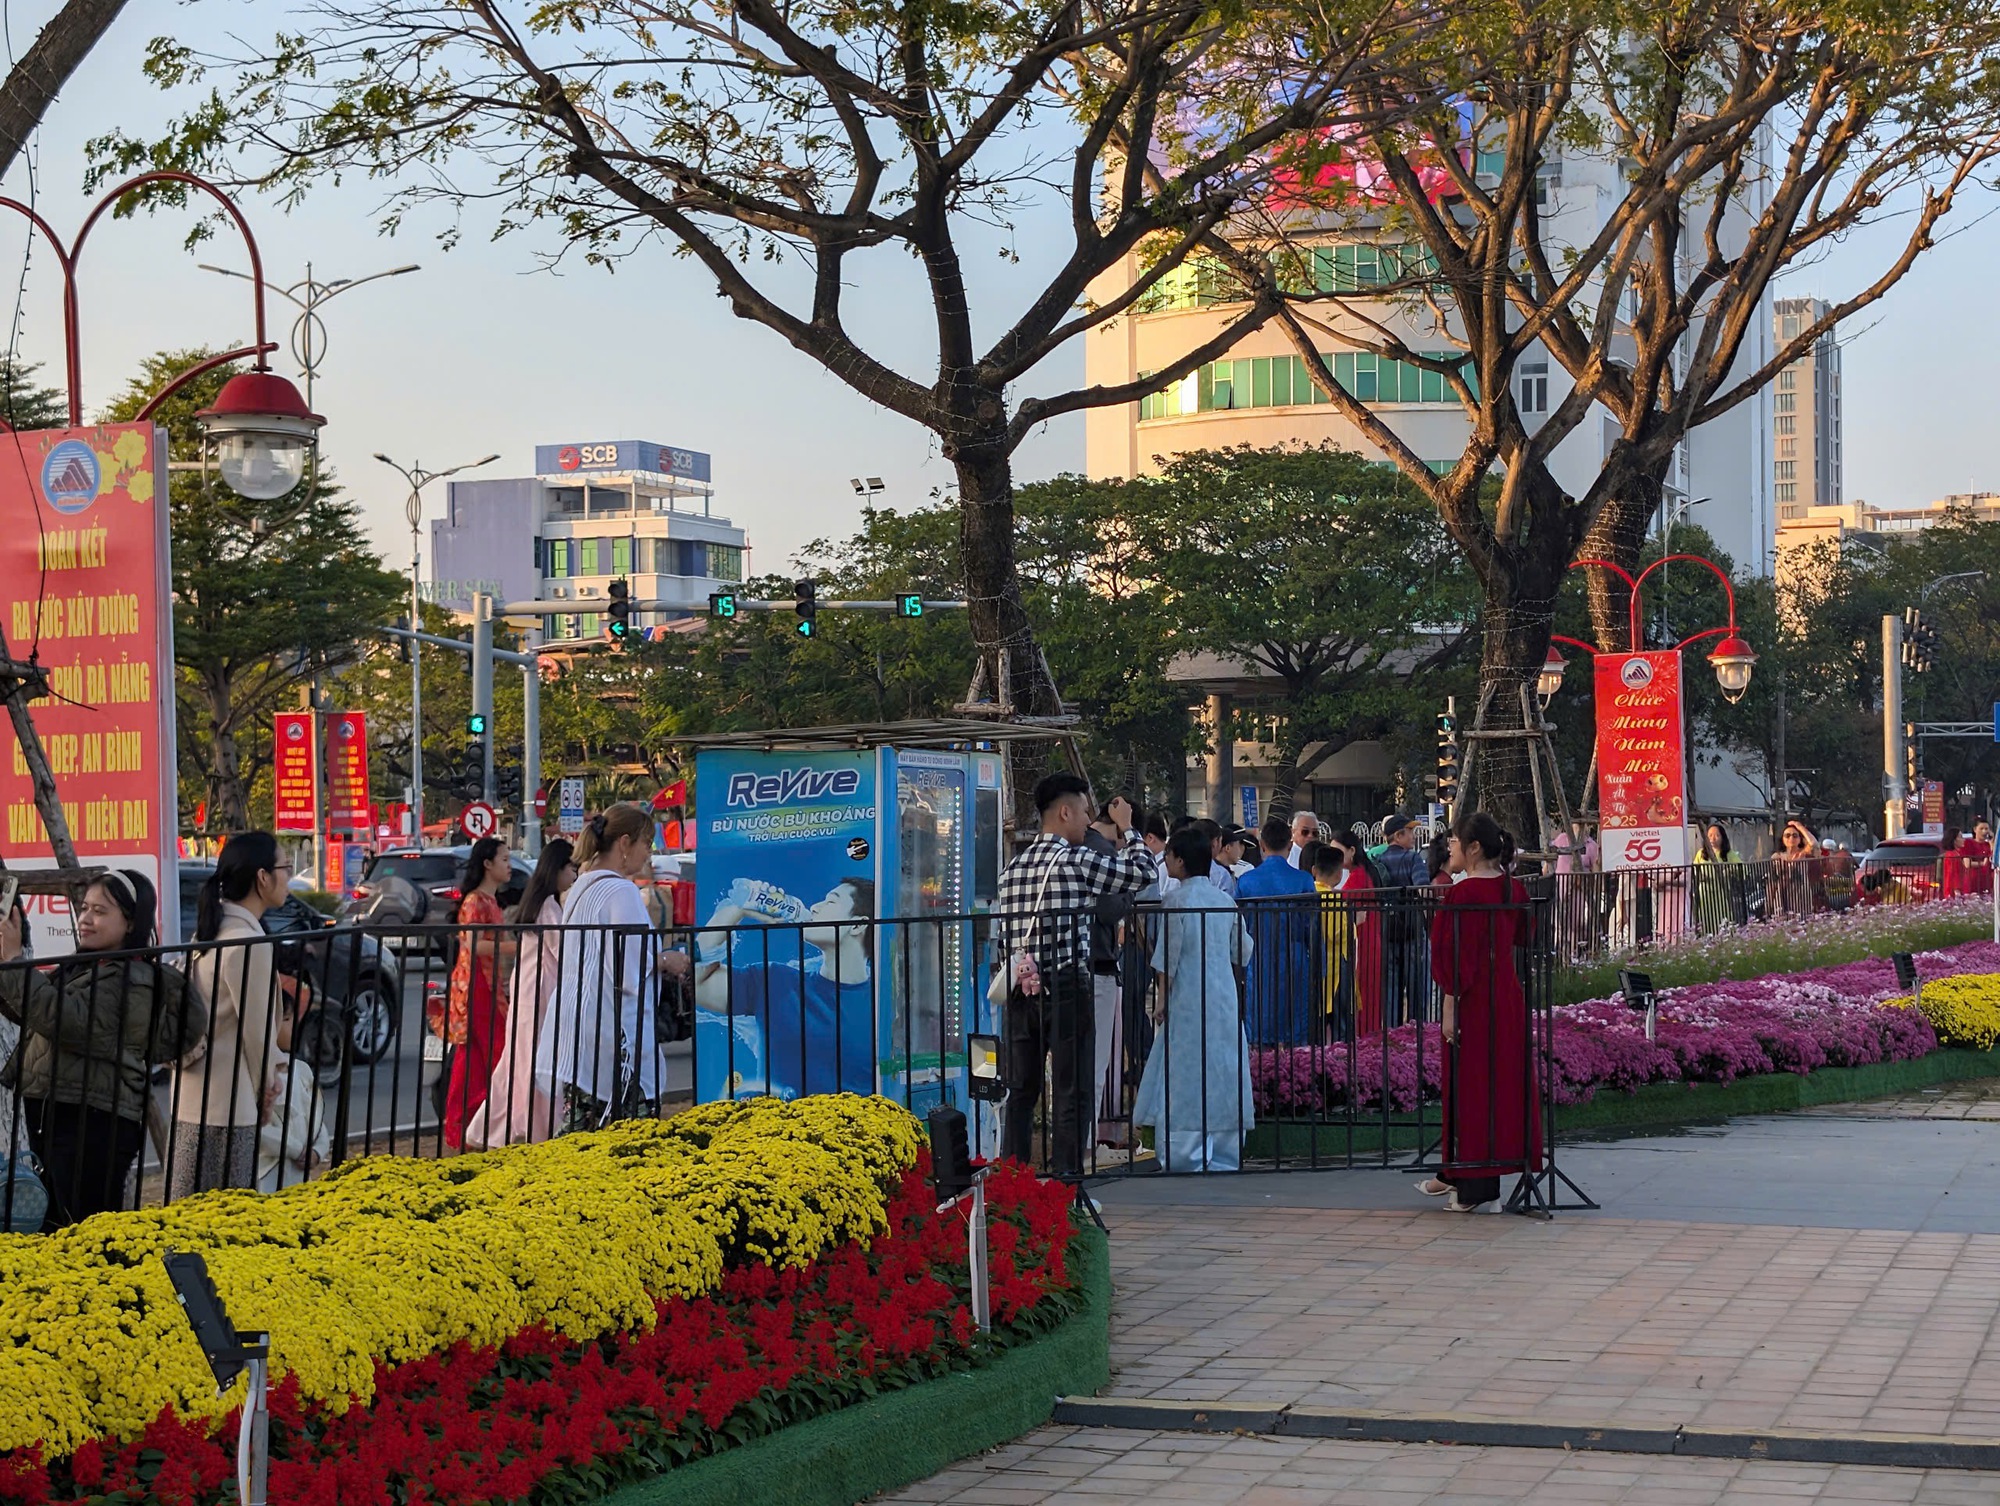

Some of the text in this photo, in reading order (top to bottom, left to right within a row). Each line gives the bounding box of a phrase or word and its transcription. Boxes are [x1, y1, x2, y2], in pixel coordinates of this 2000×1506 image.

[581, 445, 618, 463] SCB
[672, 451, 693, 469] SCB
[81, 515, 108, 568] KẾT
[12, 589, 139, 642] RA SỨC XÂY DỰNG
[718, 596, 735, 617] 15
[904, 595, 922, 616] 15
[54, 652, 83, 706] PHỐ
[87, 658, 107, 704] ĐÀ
[111, 651, 150, 703] NẴNG
[51, 734, 79, 781] ĐẸP,
[83, 732, 102, 773] AN
[106, 725, 142, 773] BÌNH
[1613, 737, 1666, 751] Năm
[8, 797, 37, 844] VĂN
[85, 794, 119, 848] HIỆN
[123, 799, 148, 848] ĐẠI
[711, 805, 876, 833] BÙ NƯỚC BÙ KHOÁNG
[749, 827, 837, 844] TRỞ LẠI CUỘC VUI
[1630, 829, 1660, 837] viettel
[1624, 838, 1662, 863] 5G
[46, 926, 74, 937] Theo
